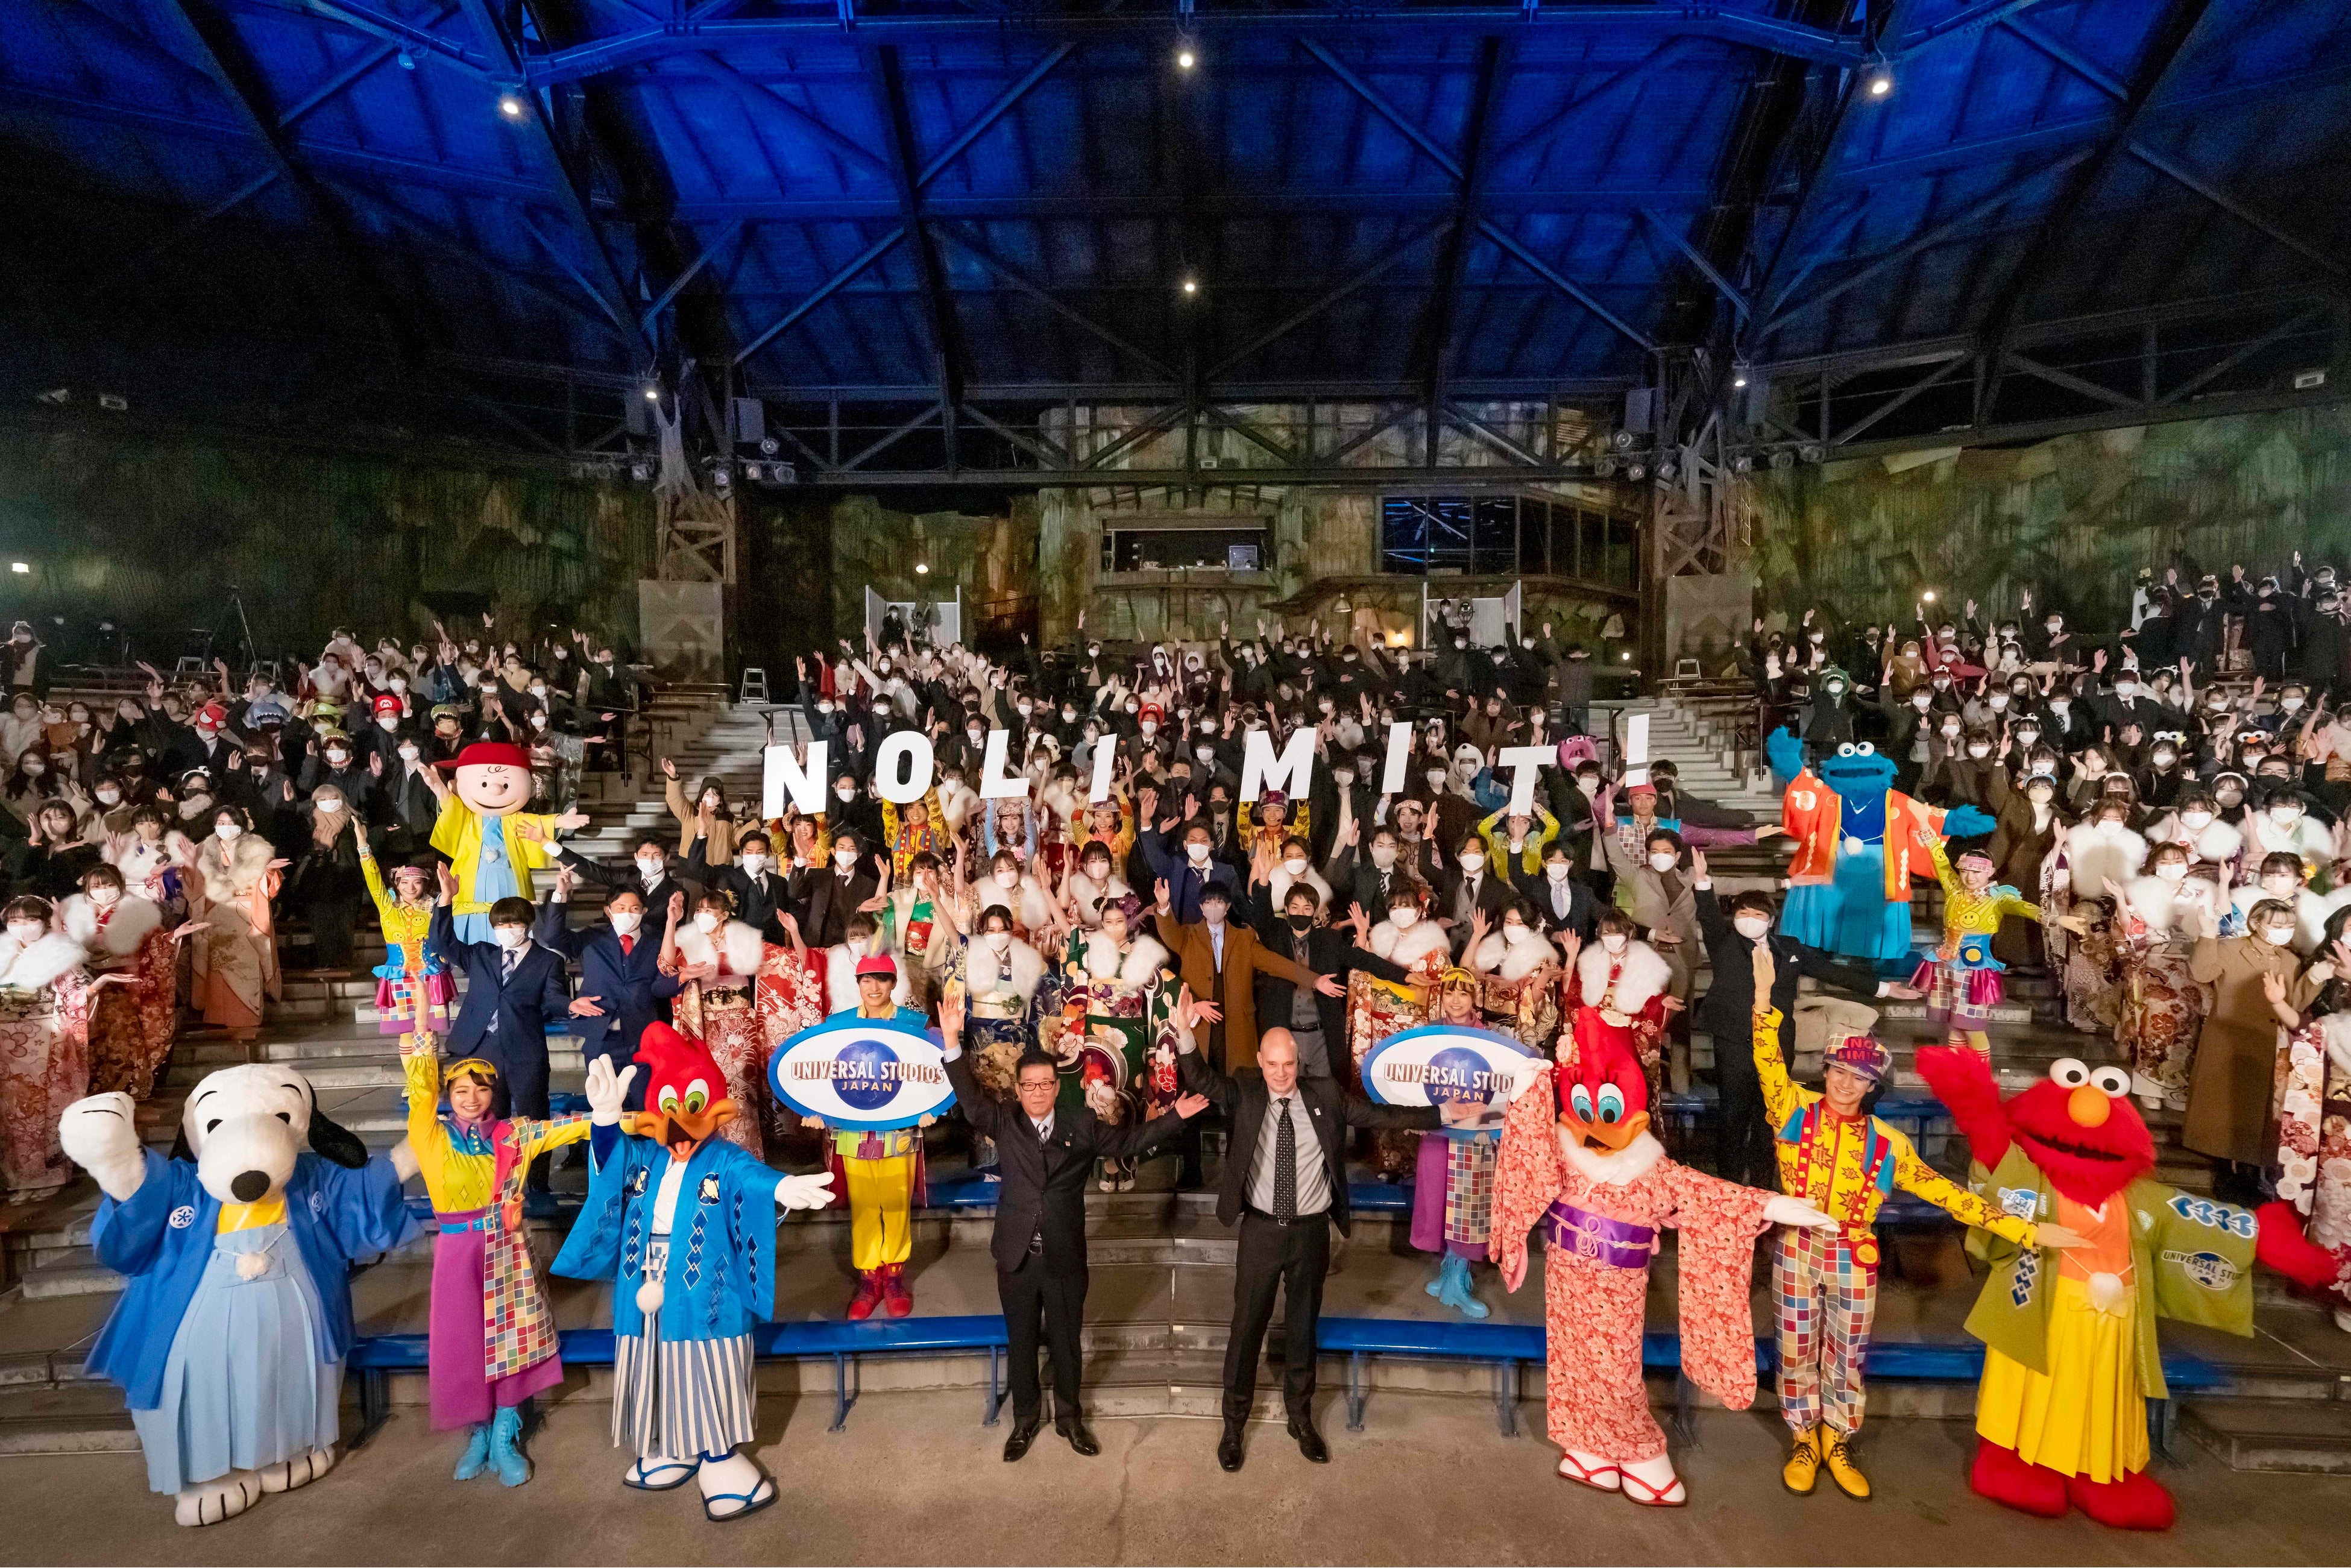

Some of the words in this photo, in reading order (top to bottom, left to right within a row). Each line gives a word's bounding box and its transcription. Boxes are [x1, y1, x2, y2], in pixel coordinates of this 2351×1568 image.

[1850, 1038, 1874, 1050] NO
[792, 1061, 875, 1080] UNIVERSAL
[880, 1062, 945, 1084] STUDIOS
[1383, 1063, 1467, 1087] UNIVERSAL
[1473, 1071, 1514, 1094] STUD
[842, 1082, 893, 1092] JAPAN
[1432, 1087, 1485, 1102] JAPAN
[2164, 1251, 2217, 1274] UNIVERSAL
[2192, 1267, 2225, 1283] JAPAN
